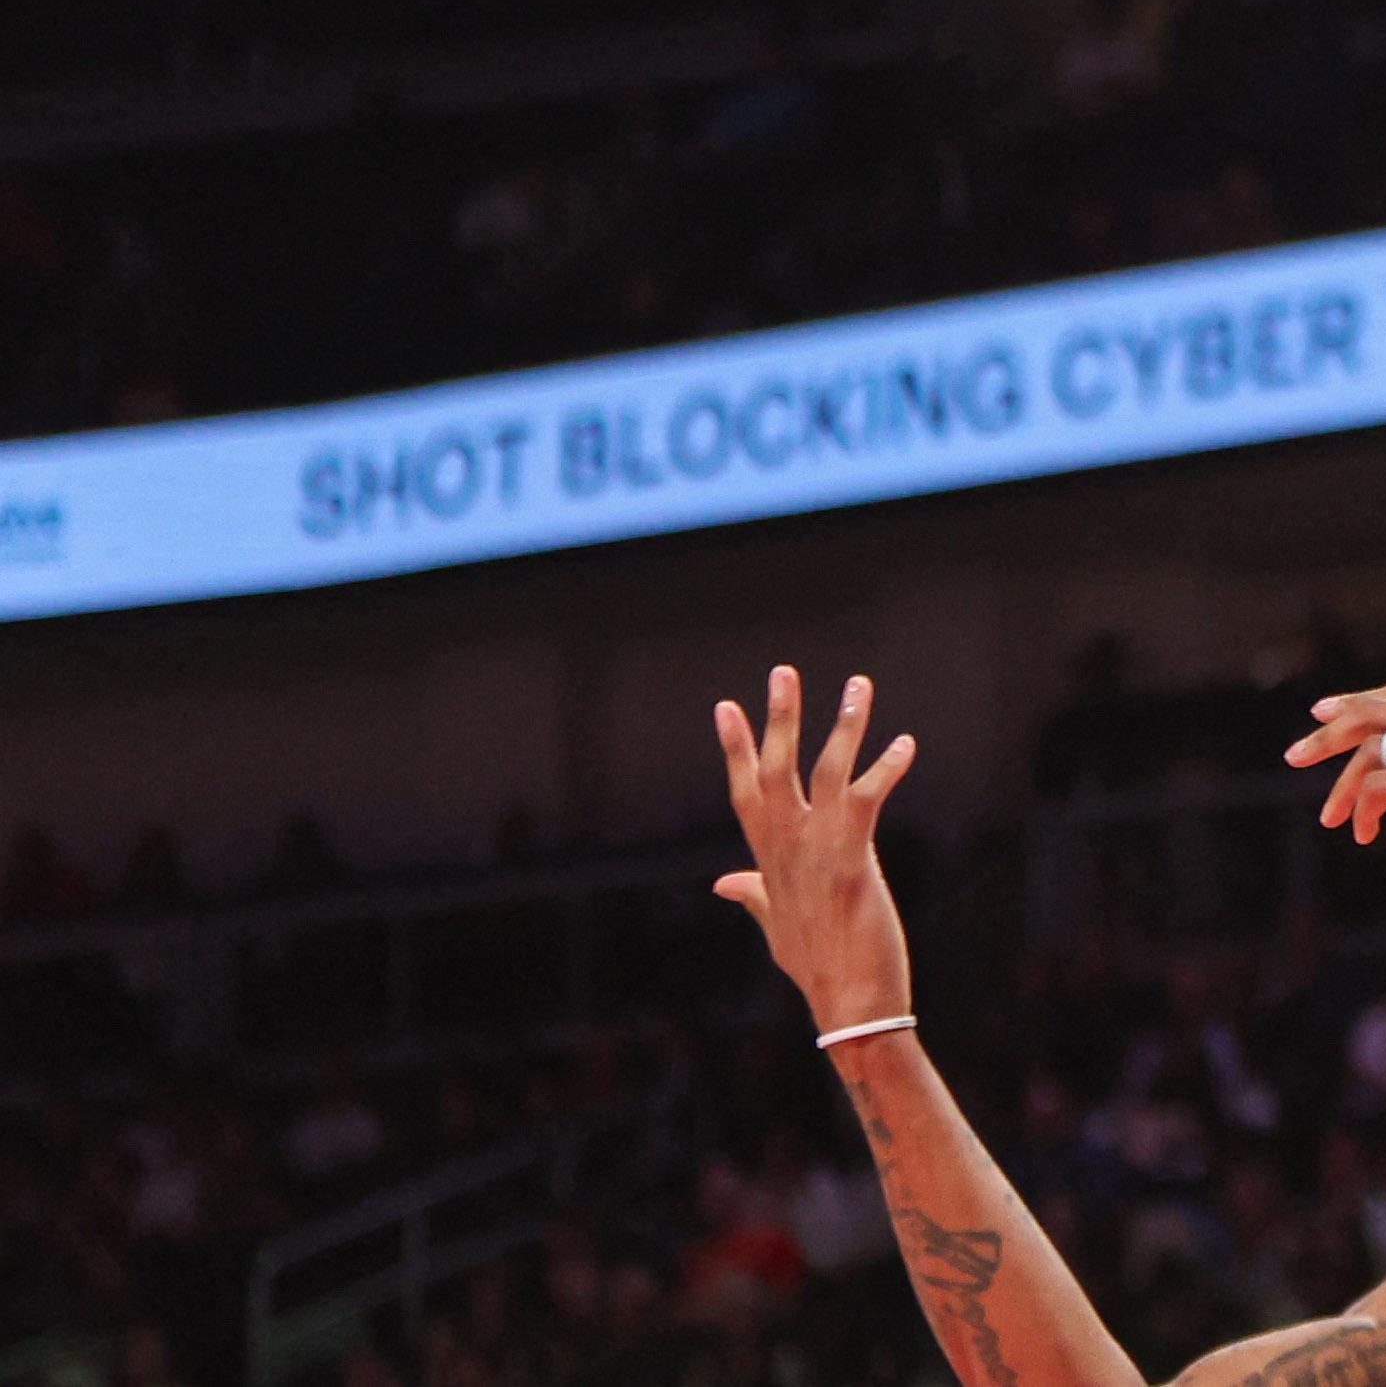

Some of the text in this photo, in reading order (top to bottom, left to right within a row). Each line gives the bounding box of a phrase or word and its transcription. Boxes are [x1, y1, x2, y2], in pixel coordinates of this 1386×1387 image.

[297, 421, 530, 542] SHOT
[559, 340, 1024, 498] BLOCKING
[1050, 287, 1368, 420] CYBER
